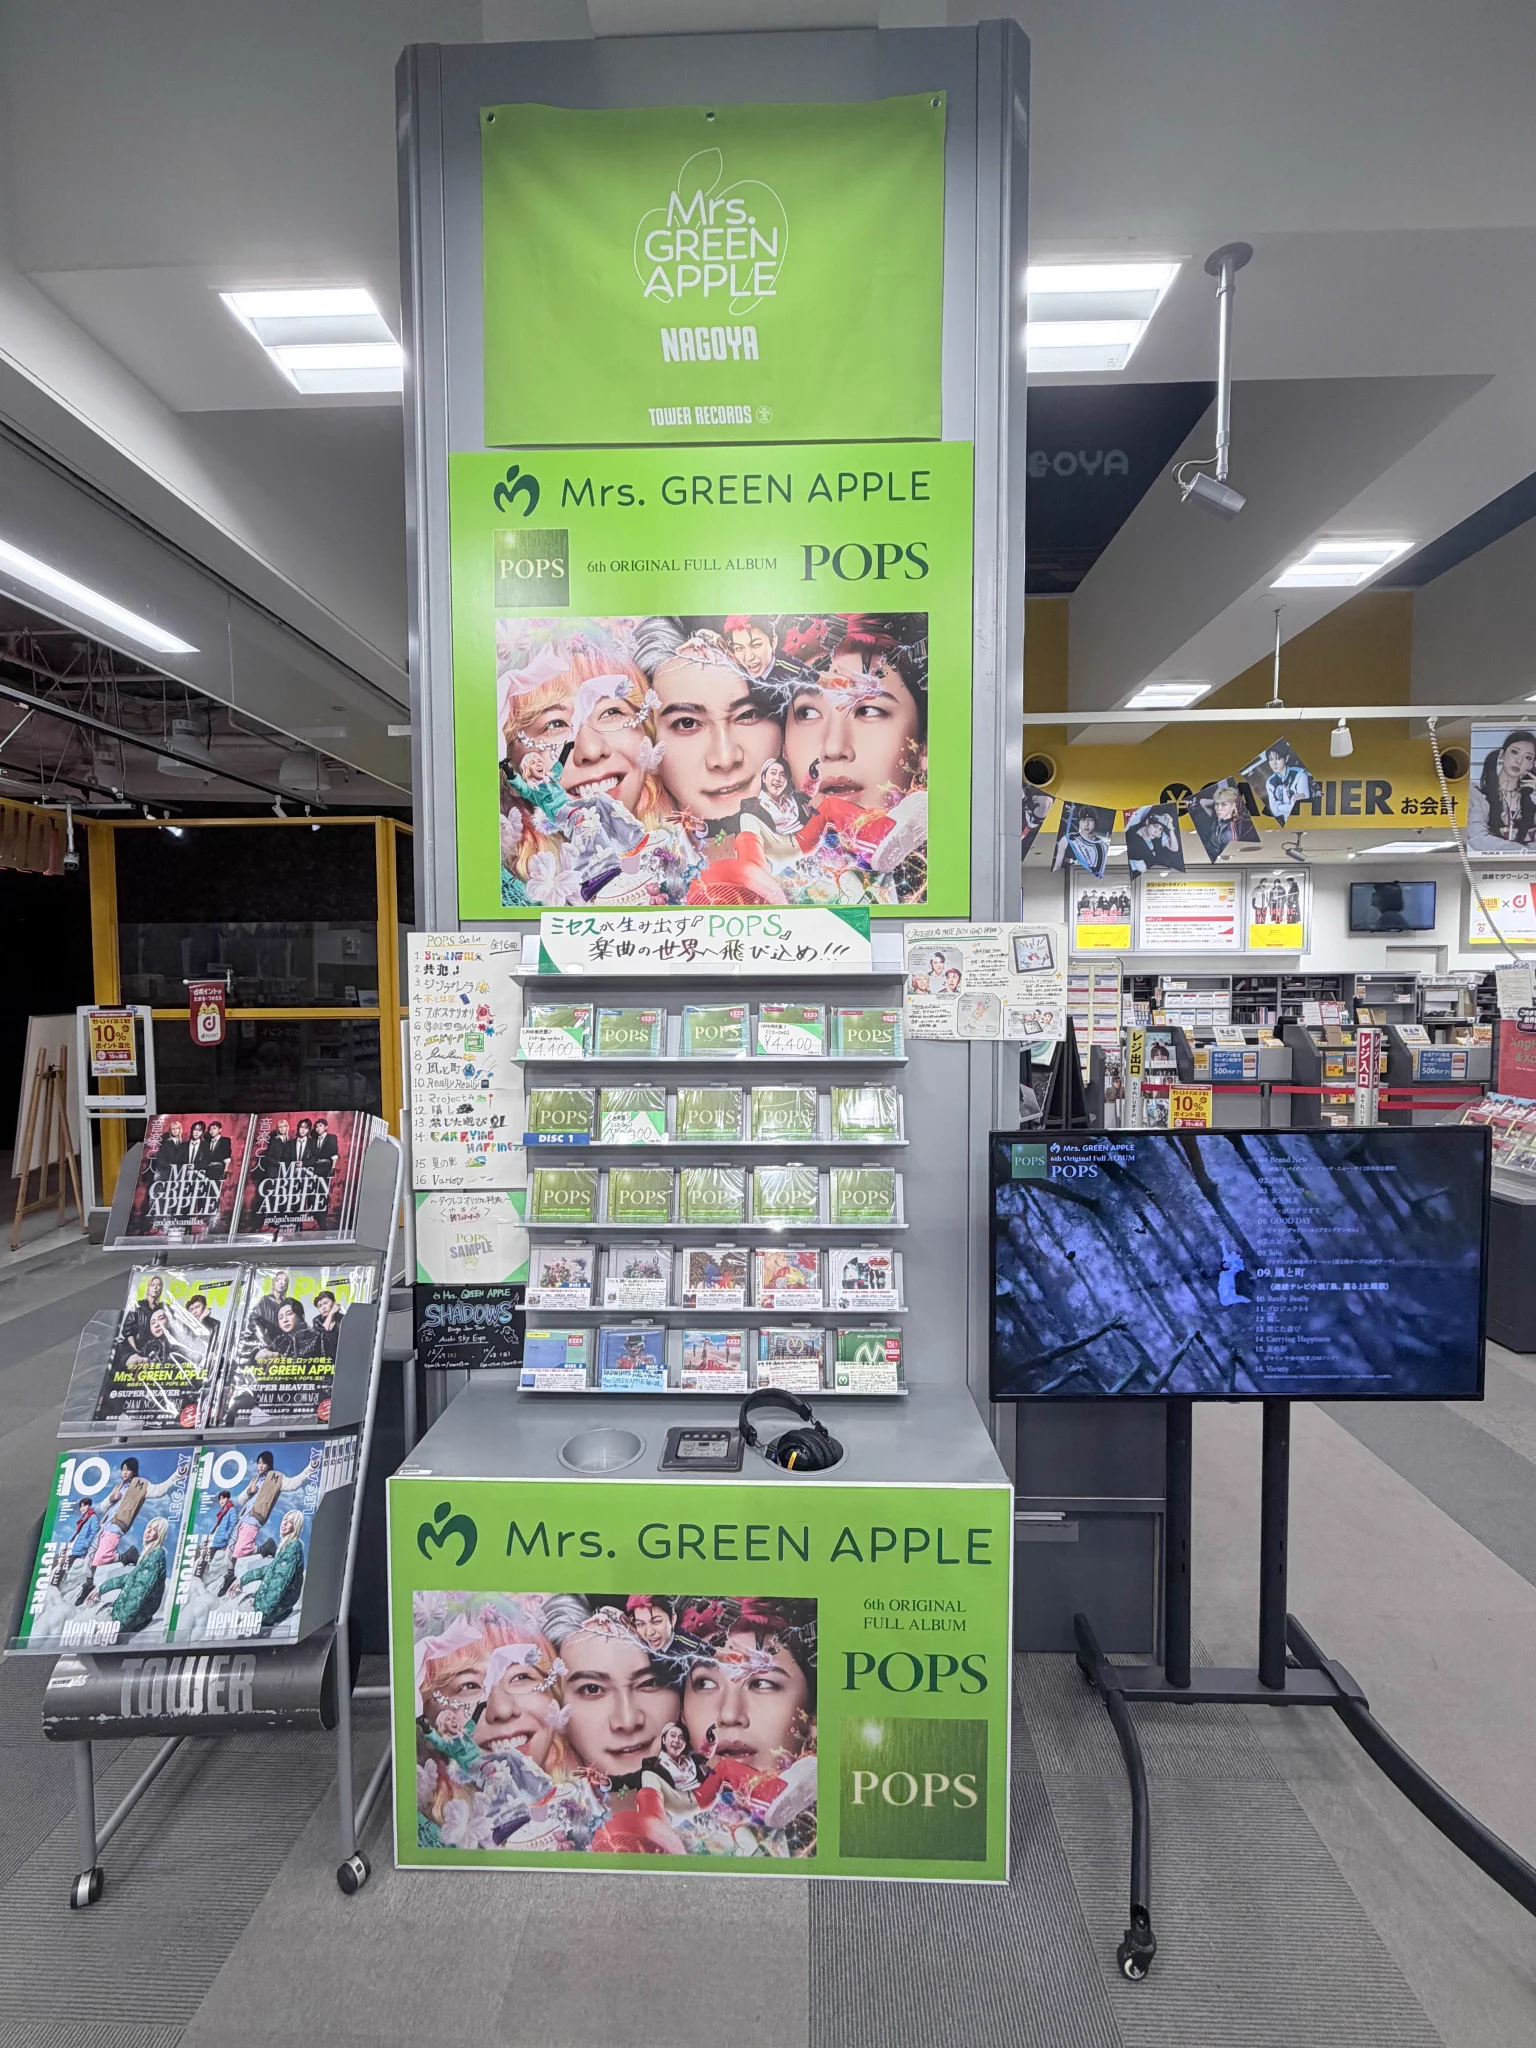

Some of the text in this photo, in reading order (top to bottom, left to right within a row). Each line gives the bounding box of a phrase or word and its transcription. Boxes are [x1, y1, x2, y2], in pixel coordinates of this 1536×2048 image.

[666, 190, 755, 226] Mrs.
[644, 227, 777, 262] GREEN
[643, 262, 777, 297] APPLE
[661, 326, 759, 362] NAGOYA
[648, 405, 752, 426] TOWER RECORDS
[561, 471, 931, 507] Mrs. GREEN APPLE
[500, 558, 565, 579] POPS
[587, 558, 778, 573] 6th ORIGINAL FULL ALBUM
[801, 542, 929, 581] POPS
[1400, 797, 1458, 817] お会計
[427, 935, 455, 947] POPS
[93, 1025, 127, 1042] 10%
[605, 1029, 648, 1042] POPS
[848, 1029, 892, 1042] POPS
[1131, 1032, 1143, 1075] レジ出口
[1360, 1035, 1371, 1086] レジ入口
[427, 1078, 454, 1090] Really
[456, 1079, 479, 1090] Really
[1173, 1096, 1203, 1112] 10%
[541, 1110, 588, 1124] POPS
[688, 1110, 735, 1124] POPS
[251, 1117, 273, 1172] 音楽と人
[431, 1131, 494, 1142] CARRYING
[538, 1134, 573, 1142] DISC 1
[142, 1119, 166, 1175] 音楽と人
[278, 1161, 318, 1179] Mrs.
[1014, 1156, 1045, 1166] POPS
[169, 1163, 209, 1181] Mrs.
[432, 1175, 464, 1185] Variety
[1051, 1165, 1098, 1177] POPS
[149, 1180, 226, 1200] GREEN
[258, 1177, 333, 1197] GREEN
[256, 1194, 328, 1215] APPLE
[544, 1190, 591, 1204] POPS
[619, 1190, 667, 1204] POPS
[692, 1190, 739, 1204] POPS
[765, 1190, 813, 1204] POPS
[842, 1190, 889, 1204] POPS
[145, 1197, 219, 1216] APPLE
[456, 1233, 487, 1243] POPS
[450, 1241, 494, 1259] SAMPLE
[1275, 1267, 1305, 1277] 風と町
[461, 1288, 484, 1299] GREEN
[487, 1288, 511, 1298] APPLE
[424, 1301, 513, 1327] SHADOWS
[1266, 1336, 1296, 1344] Carrying
[113, 1369, 208, 1382] Mrs. GREEN APPLE
[243, 1364, 335, 1376] Mrs. GREEN APPL
[1266, 1366, 1289, 1374] Variety
[117, 1390, 145, 1398] SUPER
[249, 1384, 277, 1392] SUPER
[61, 1456, 110, 1496] 10
[201, 1450, 248, 1490] 10
[168, 1453, 192, 1524] LEGACY
[303, 1447, 323, 1515] LEGACY
[506, 1520, 992, 1565] Mrs. GREEN APPLE
[175, 1533, 199, 1605] FUTURE
[30, 1542, 58, 1615] FUTURE
[863, 1597, 967, 1613] 6th ORIGINAL
[206, 1610, 263, 1637] Heritage
[863, 1617, 967, 1632] FULL ALBUM
[59, 1620, 120, 1647] Heritage
[841, 1651, 988, 1694] POPS
[121, 1654, 256, 1719] TOWER
[851, 1770, 978, 1809] POPS
